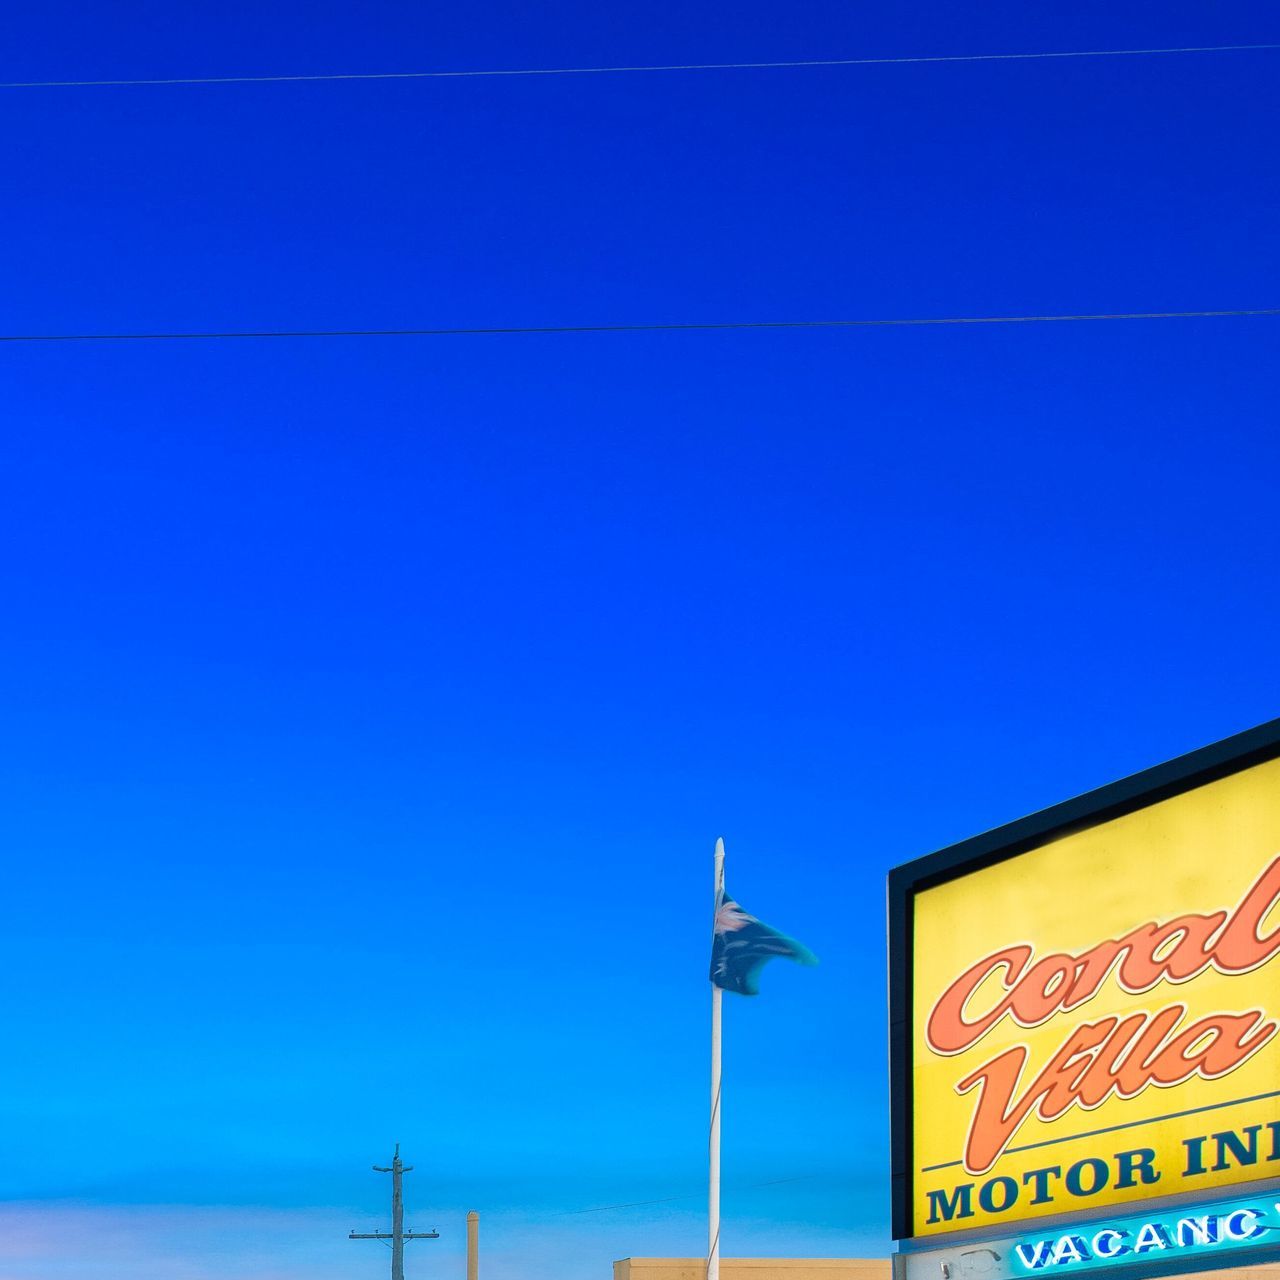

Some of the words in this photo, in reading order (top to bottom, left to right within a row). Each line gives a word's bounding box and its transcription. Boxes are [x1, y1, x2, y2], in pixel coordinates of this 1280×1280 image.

[926, 855, 1280, 1056] Coral
[954, 1005, 1278, 1176] Villa
[925, 1147, 1161, 1225] MOTOR
[1015, 1200, 1280, 1270] VACANC
